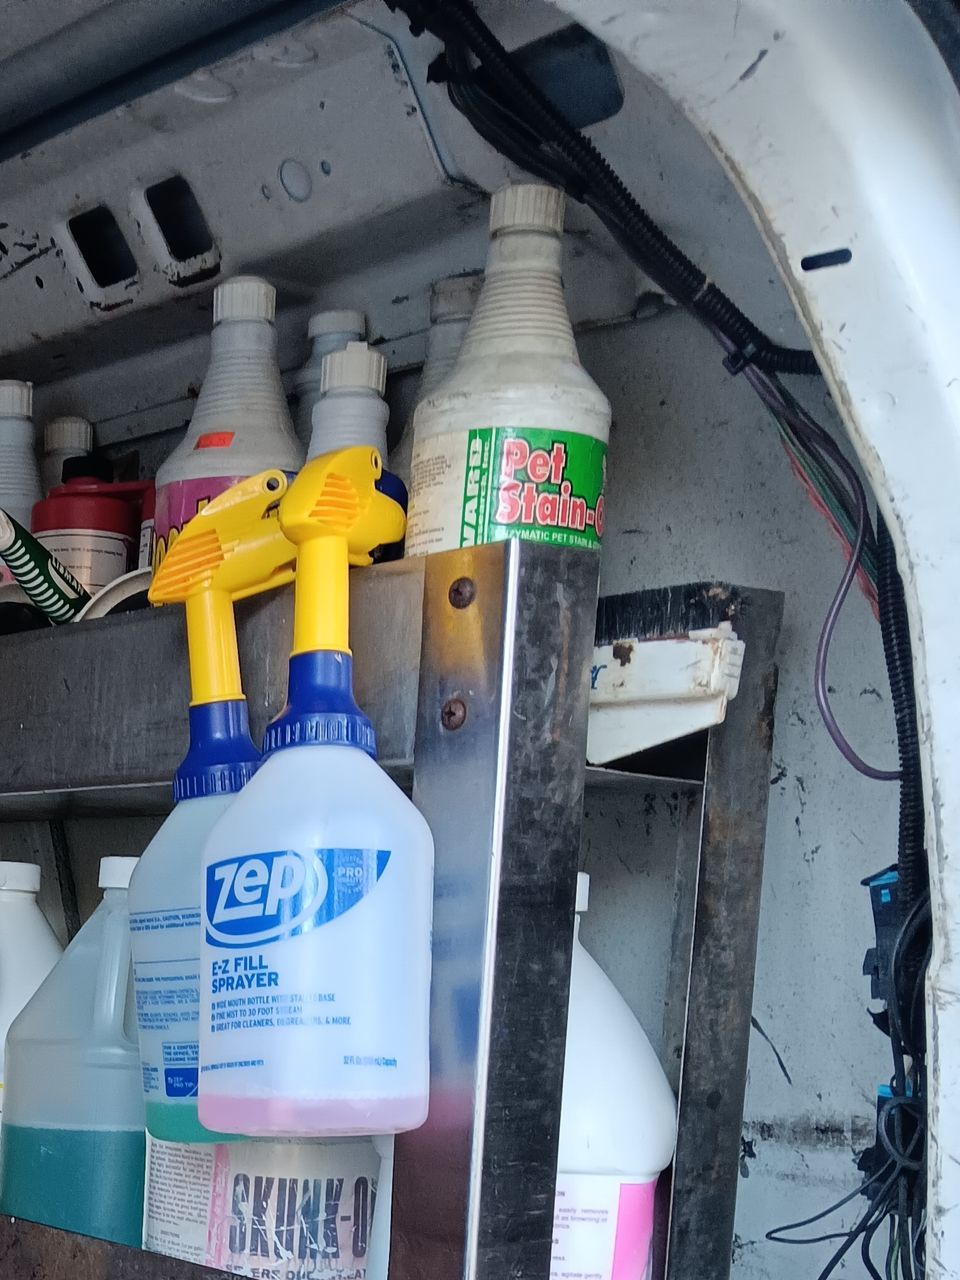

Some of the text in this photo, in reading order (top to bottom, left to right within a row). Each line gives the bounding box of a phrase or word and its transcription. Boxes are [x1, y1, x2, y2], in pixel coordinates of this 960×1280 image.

[501, 438, 566, 484] Pet
[552, 533, 567, 543] PET
[337, 867, 363, 878] PRO
[212, 955, 268, 976] E-Z FILL
[212, 972, 279, 994] SPRAYER
[228, 998, 246, 1007] MOUTH
[248, 996, 270, 1005] BOTTLE
[318, 993, 335, 1002] BASE
[227, 1011, 238, 1019] MIST
[240, 1009, 247, 1017] TO
[248, 1008, 256, 1017] 30
[258, 1007, 274, 1016] FOOT
[231, 1021, 242, 1031] FOR
[243, 1019, 274, 1029] CLEANERS,
[325, 1017, 330, 1025] &
